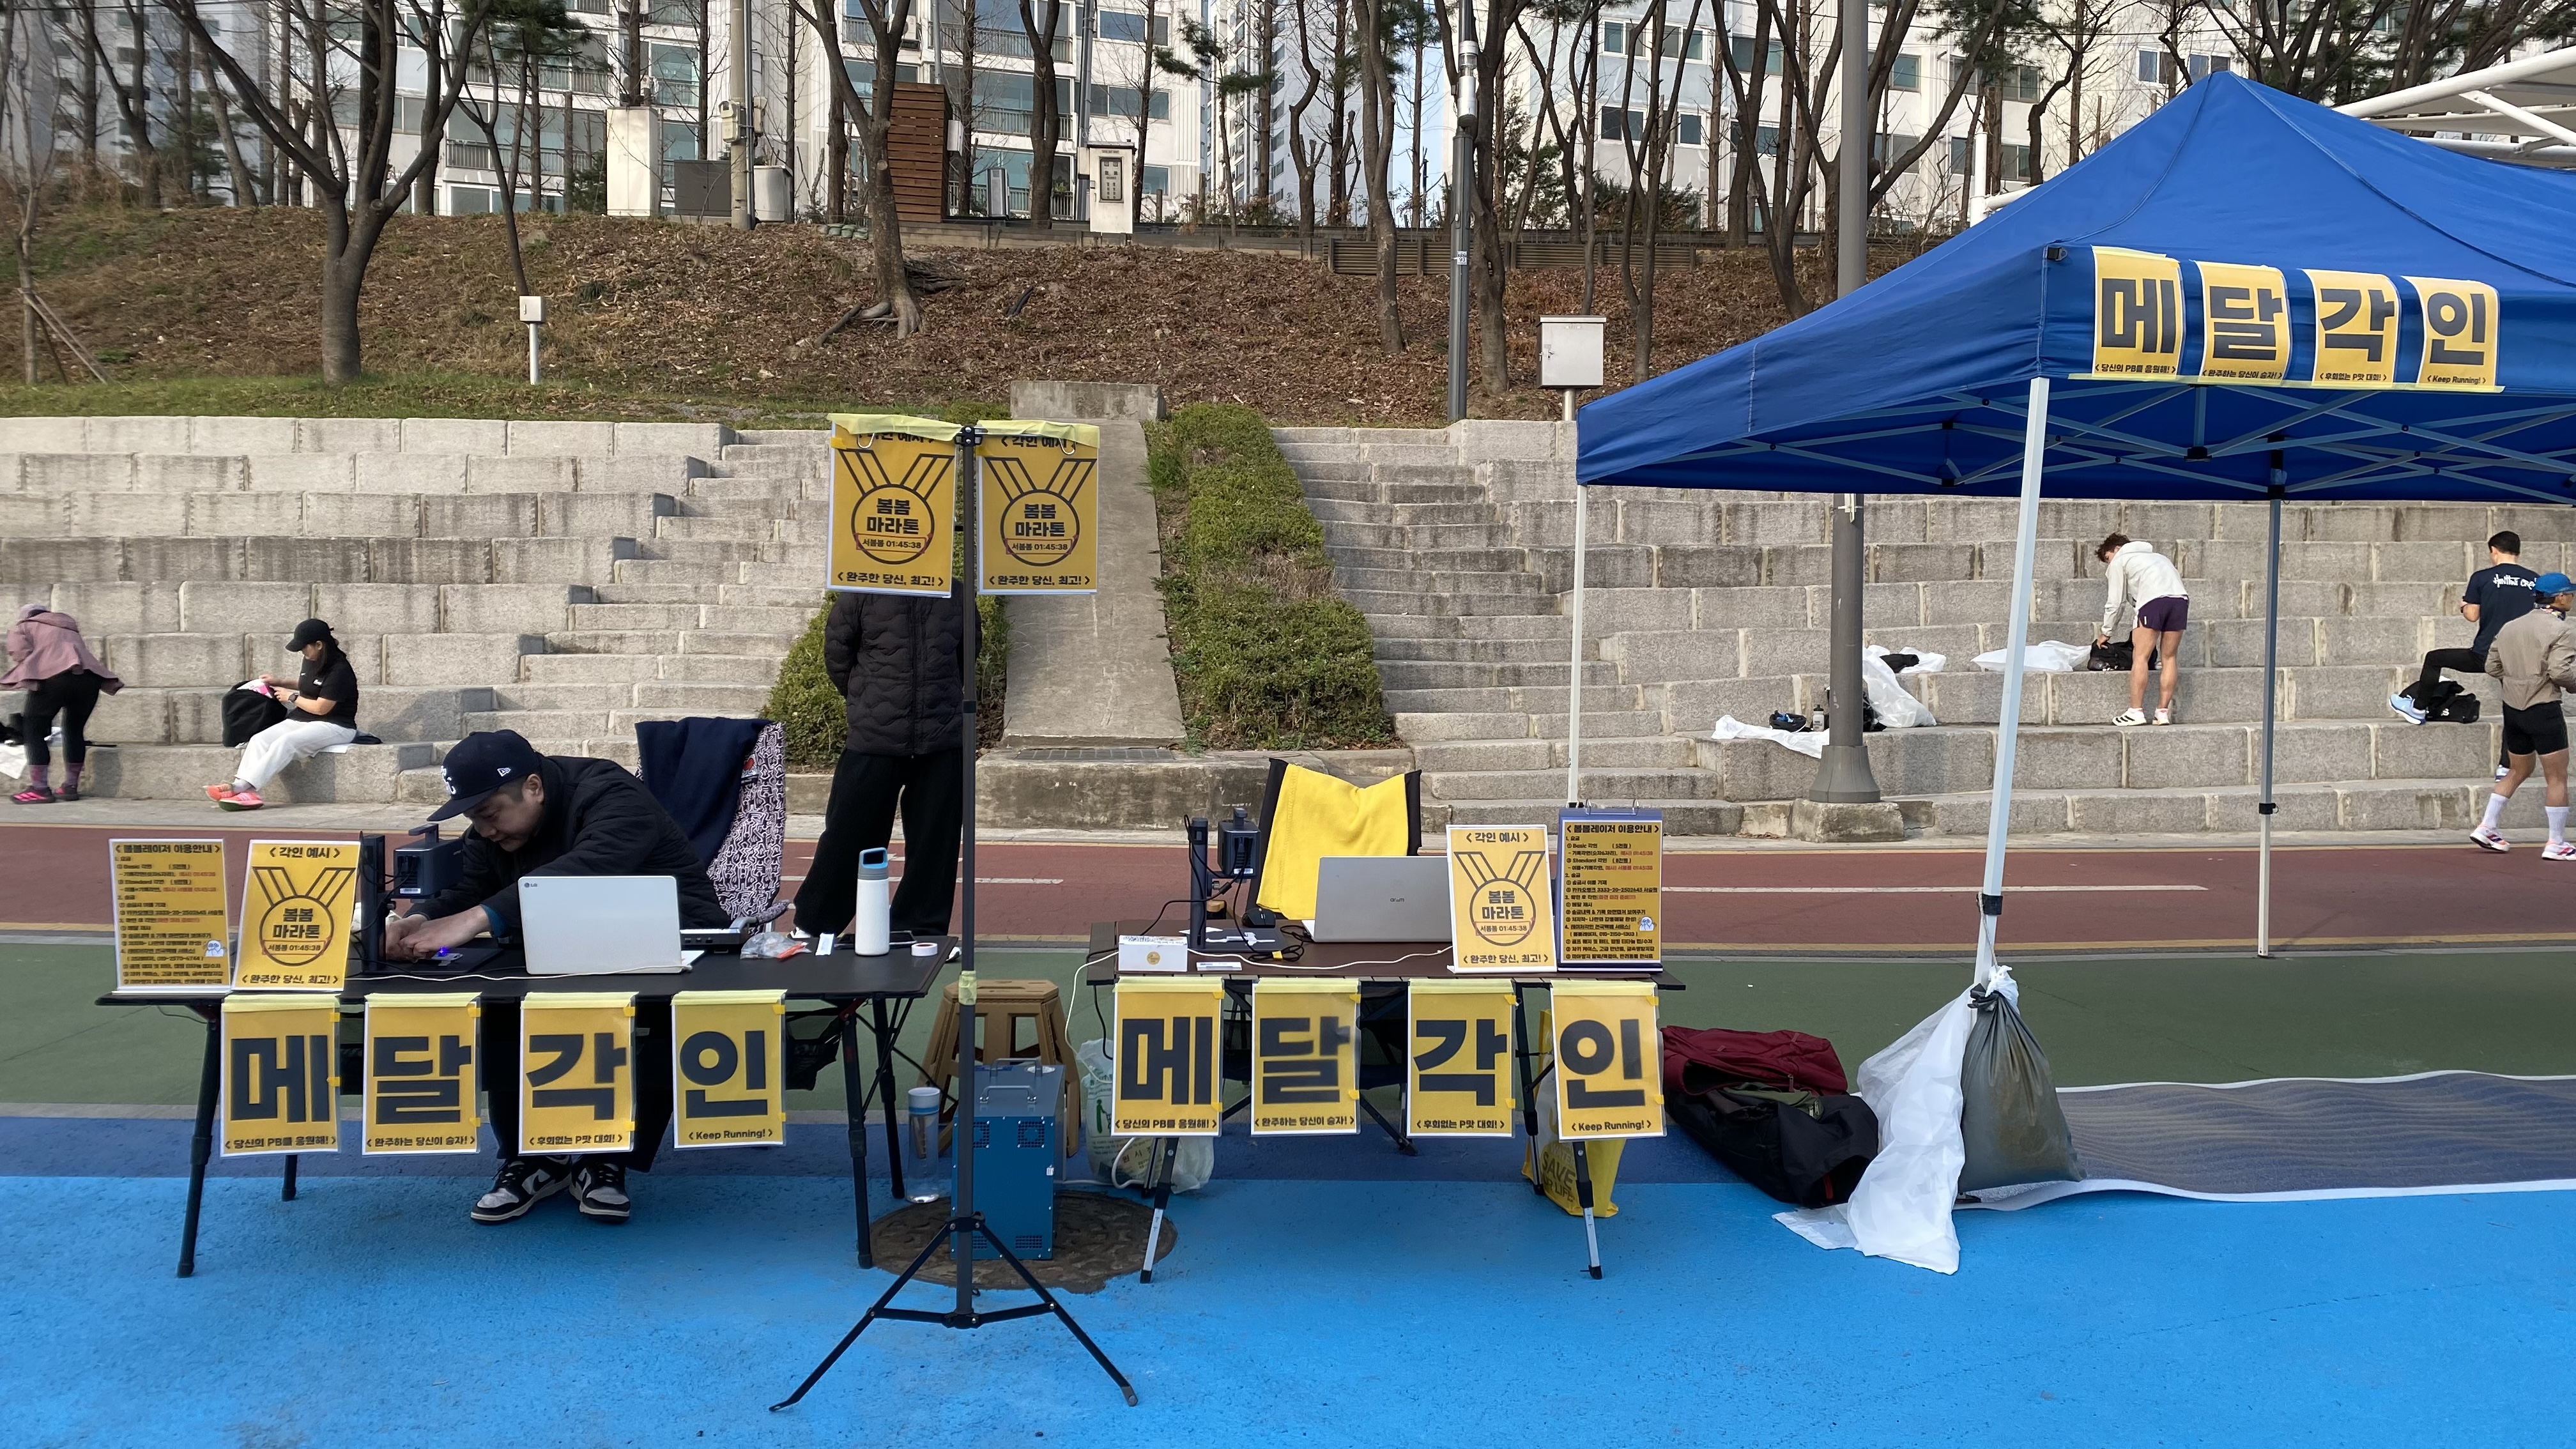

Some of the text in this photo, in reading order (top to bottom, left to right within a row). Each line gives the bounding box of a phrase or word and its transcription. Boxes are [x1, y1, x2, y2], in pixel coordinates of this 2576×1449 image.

[2101, 278, 2486, 364] 메 달 각 인
[2101, 364, 2170, 374] 당신의 PB를 응원해!
[2208, 369, 2236, 378] 완주하는
[2325, 372, 2351, 381] 후회없는
[2432, 375, 2481, 385] Keep Running!
[1012, 436, 1038, 447] 각인
[877, 498, 910, 516] 봄봄
[1024, 504, 1056, 519] 봄봄
[867, 517, 919, 535] 마라톤
[1015, 522, 1066, 537] 마라톤
[886, 540, 921, 549] 01:45:38
[847, 572, 935, 586] 완주한 당신, 최고!
[998, 576, 1082, 585] 완주한 당신, 최고!
[1618, 825, 1652, 833] 이용안내
[1475, 832, 1520, 843] 각인 예시
[279, 847, 330, 858] 각인 예시
[1489, 891, 1515, 904] 봄봄
[283, 908, 313, 922] 봄봄
[1482, 906, 1524, 919] 마라톤
[273, 925, 320, 939] 마라톤
[1470, 955, 1497, 963] 완주한
[1499, 955, 1519, 963] 당신,
[250, 975, 330, 984] 완주한 당신, 최고!
[1121, 1016, 1645, 1109] 메 달 각 인
[231, 1030, 767, 1124] 메 달 각 인
[1123, 1119, 1209, 1128] 당신의 PB를 응원해!
[1262, 1116, 1347, 1127] 완주하는 당신이 승자!
[1423, 1119, 1498, 1130] 후회없는 P맛 대회!
[1579, 1120, 1644, 1132] Keep Running!
[375, 1135, 468, 1147] 완주하는 당신이 승자!
[537, 1133, 615, 1146] 후회없는 P맛 대회!
[696, 1129, 765, 1141] Keep Running!
[233, 1135, 329, 1148] 당신의 PB를 응원해!
[1542, 1151, 1575, 1190] SAVE
